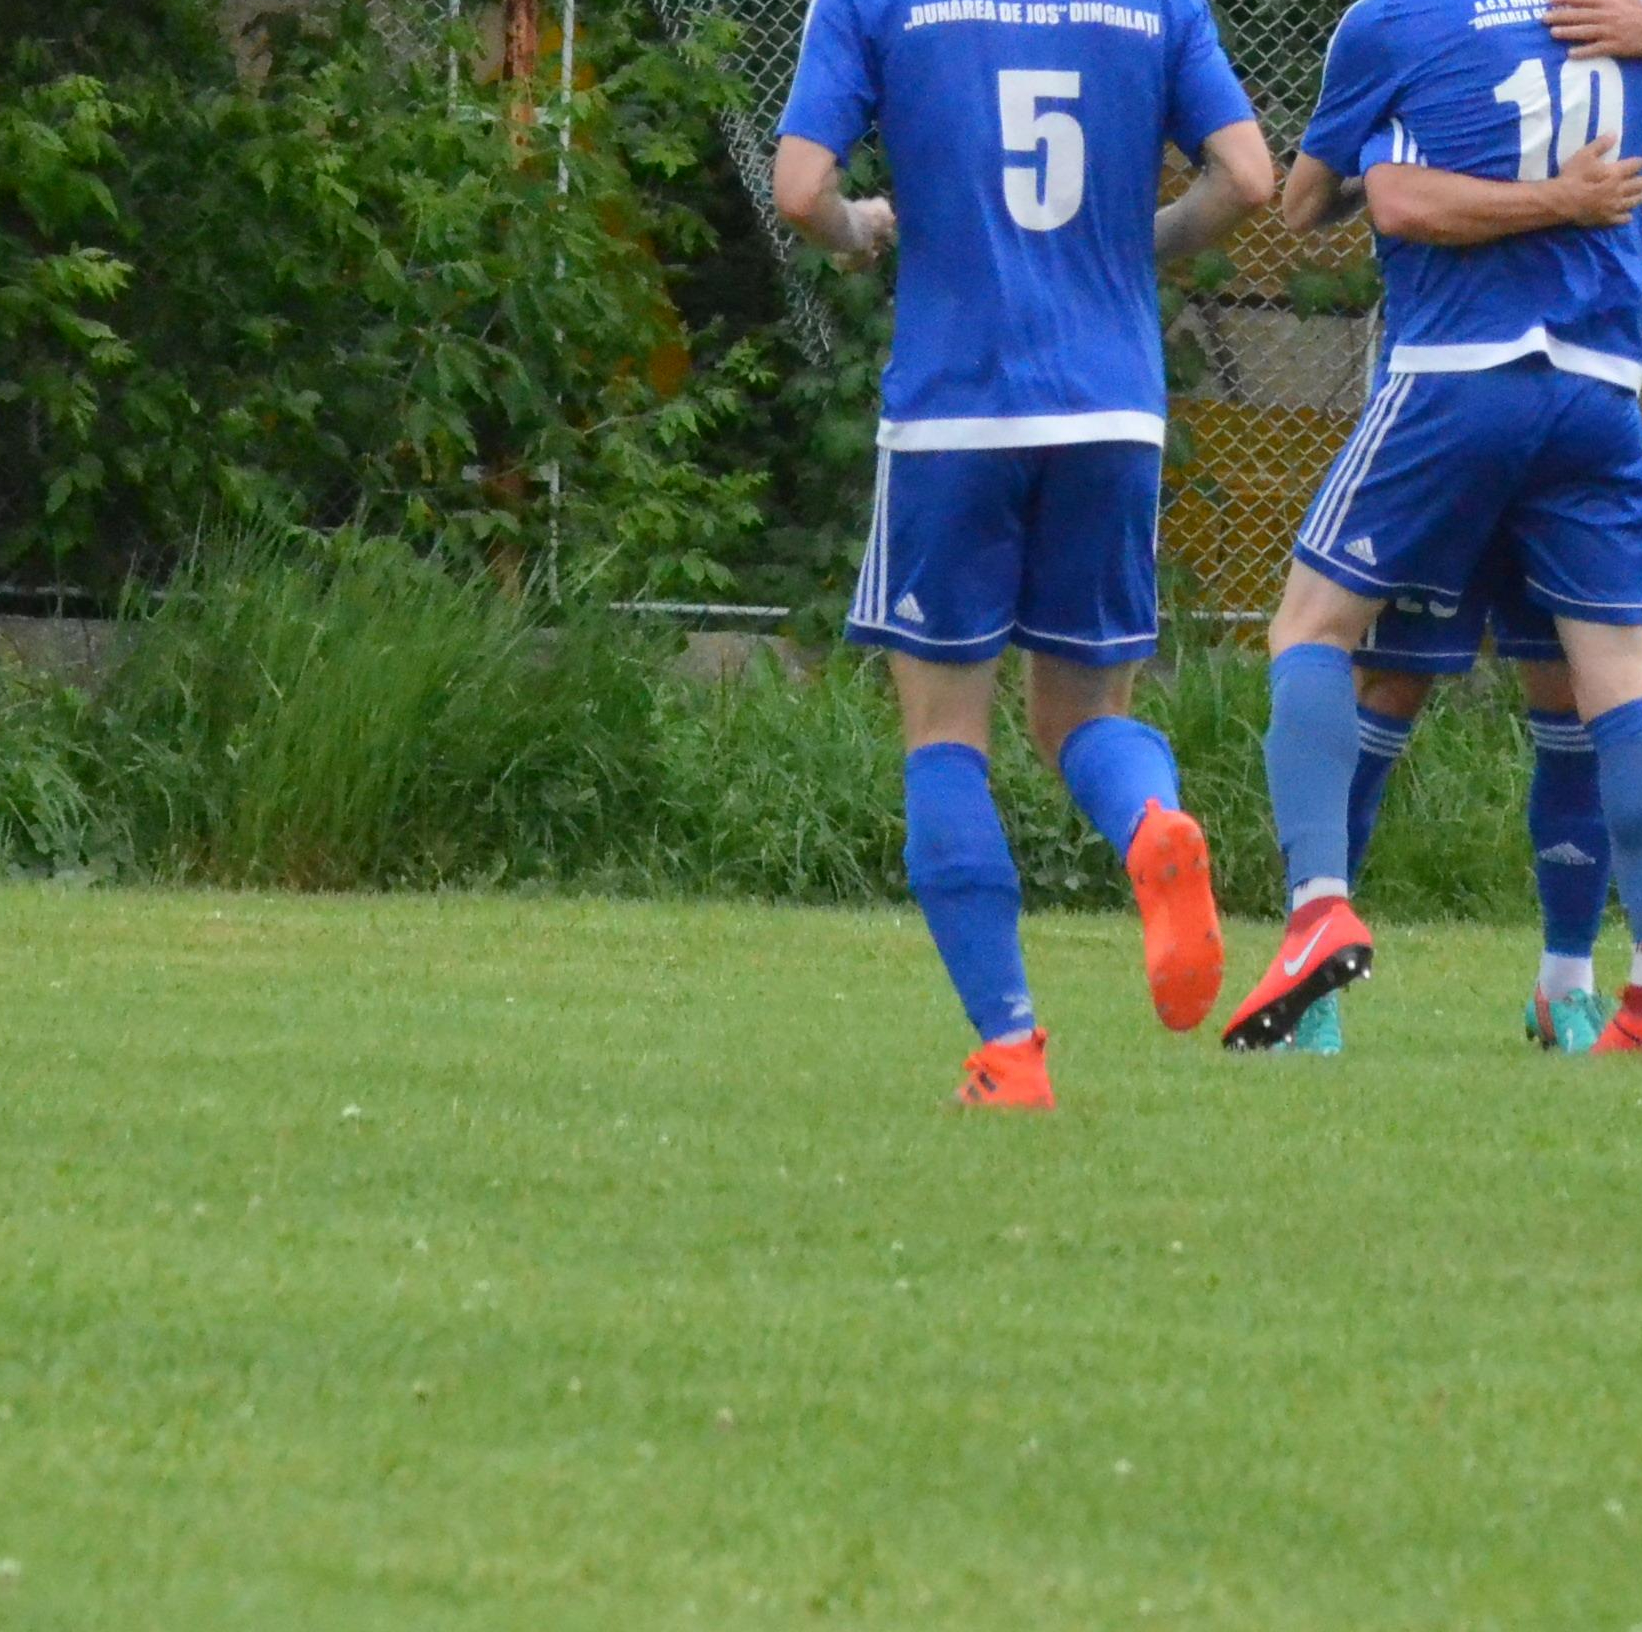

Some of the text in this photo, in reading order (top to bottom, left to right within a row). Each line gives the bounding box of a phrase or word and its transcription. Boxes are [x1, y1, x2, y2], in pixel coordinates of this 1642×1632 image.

[999, 2, 1023, 23] DE
[998, 69, 1086, 232] 5
[1494, 55, 1624, 182] 10
